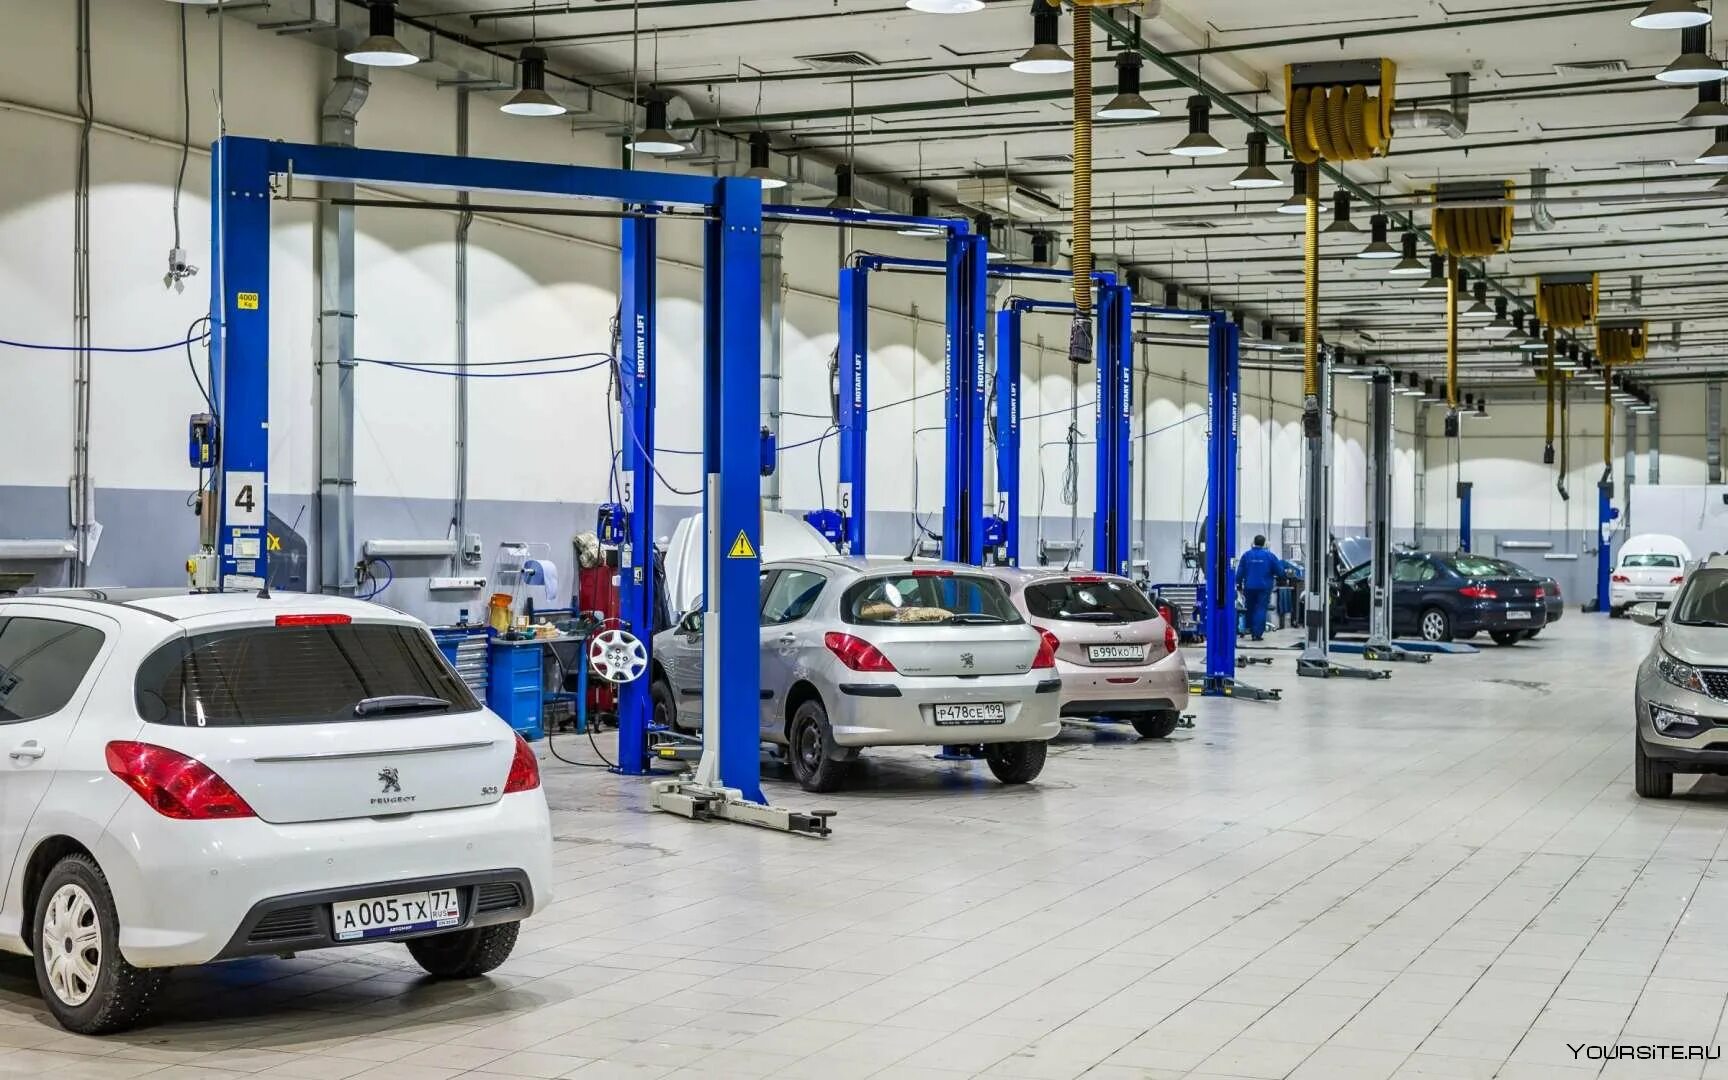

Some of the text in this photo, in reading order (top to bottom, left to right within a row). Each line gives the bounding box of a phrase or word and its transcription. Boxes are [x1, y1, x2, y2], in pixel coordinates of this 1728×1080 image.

[637, 313, 645, 373] ROTARY LIFT
[234, 485, 256, 512] 4
[624, 483, 631, 502] 5
[842, 493, 849, 509] 6
[1000, 500, 1006, 513] 7
[984, 704, 1001, 714] 199
[370, 795, 417, 805] PEUGEOT
[431, 891, 450, 911] 77
